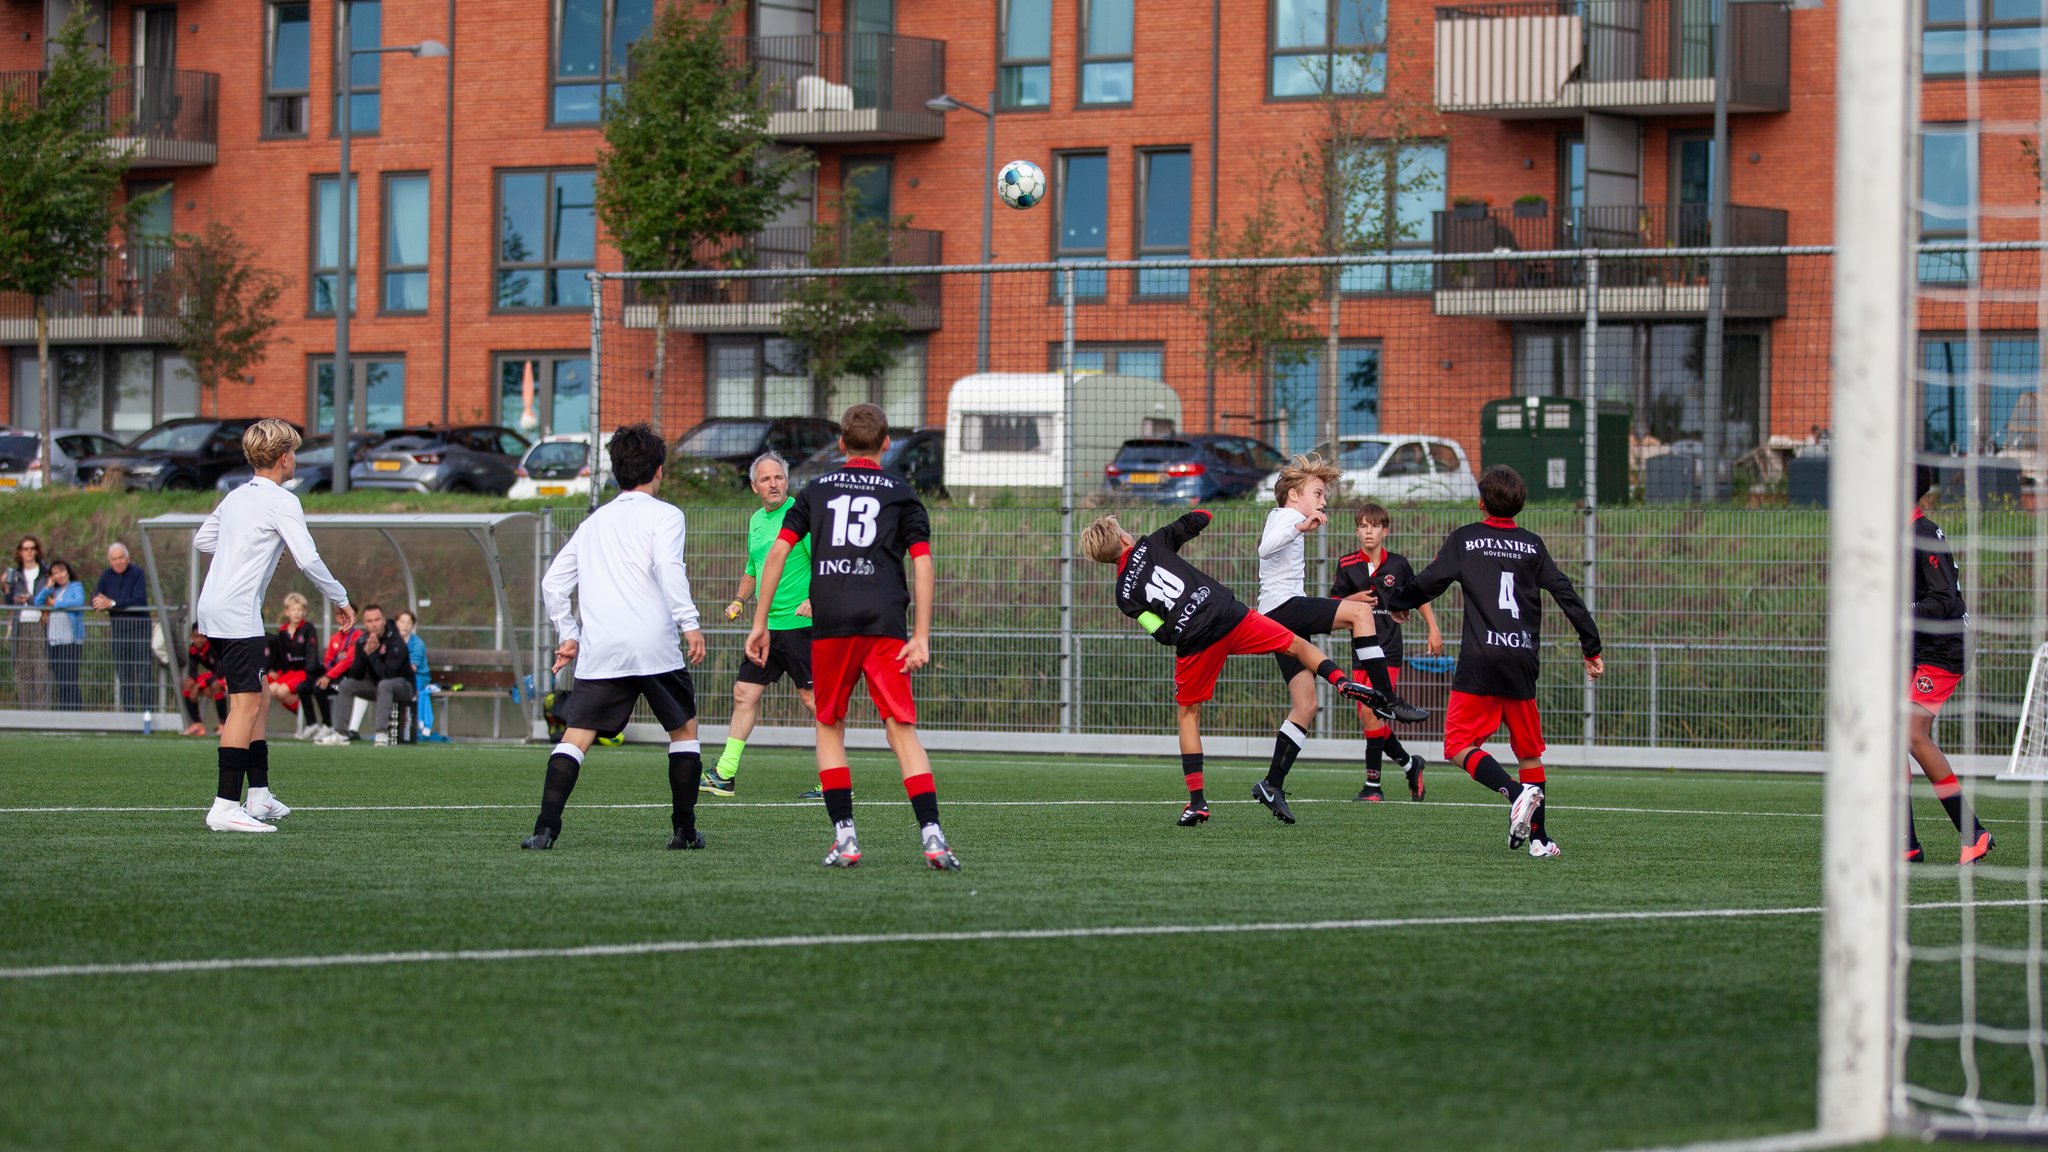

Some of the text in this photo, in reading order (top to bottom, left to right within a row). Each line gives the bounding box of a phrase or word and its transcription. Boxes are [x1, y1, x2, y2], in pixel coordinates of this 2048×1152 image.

[834, 482, 876, 492] HOVENIERS
[827, 495, 881, 548] 13
[1464, 538, 1537, 554] BOTANIEK
[1483, 550, 1522, 560] HOVENIERS
[818, 559, 852, 576] ING
[1144, 565, 1186, 612] 10
[1498, 571, 1520, 620] 4
[1486, 629, 1520, 648] ING
